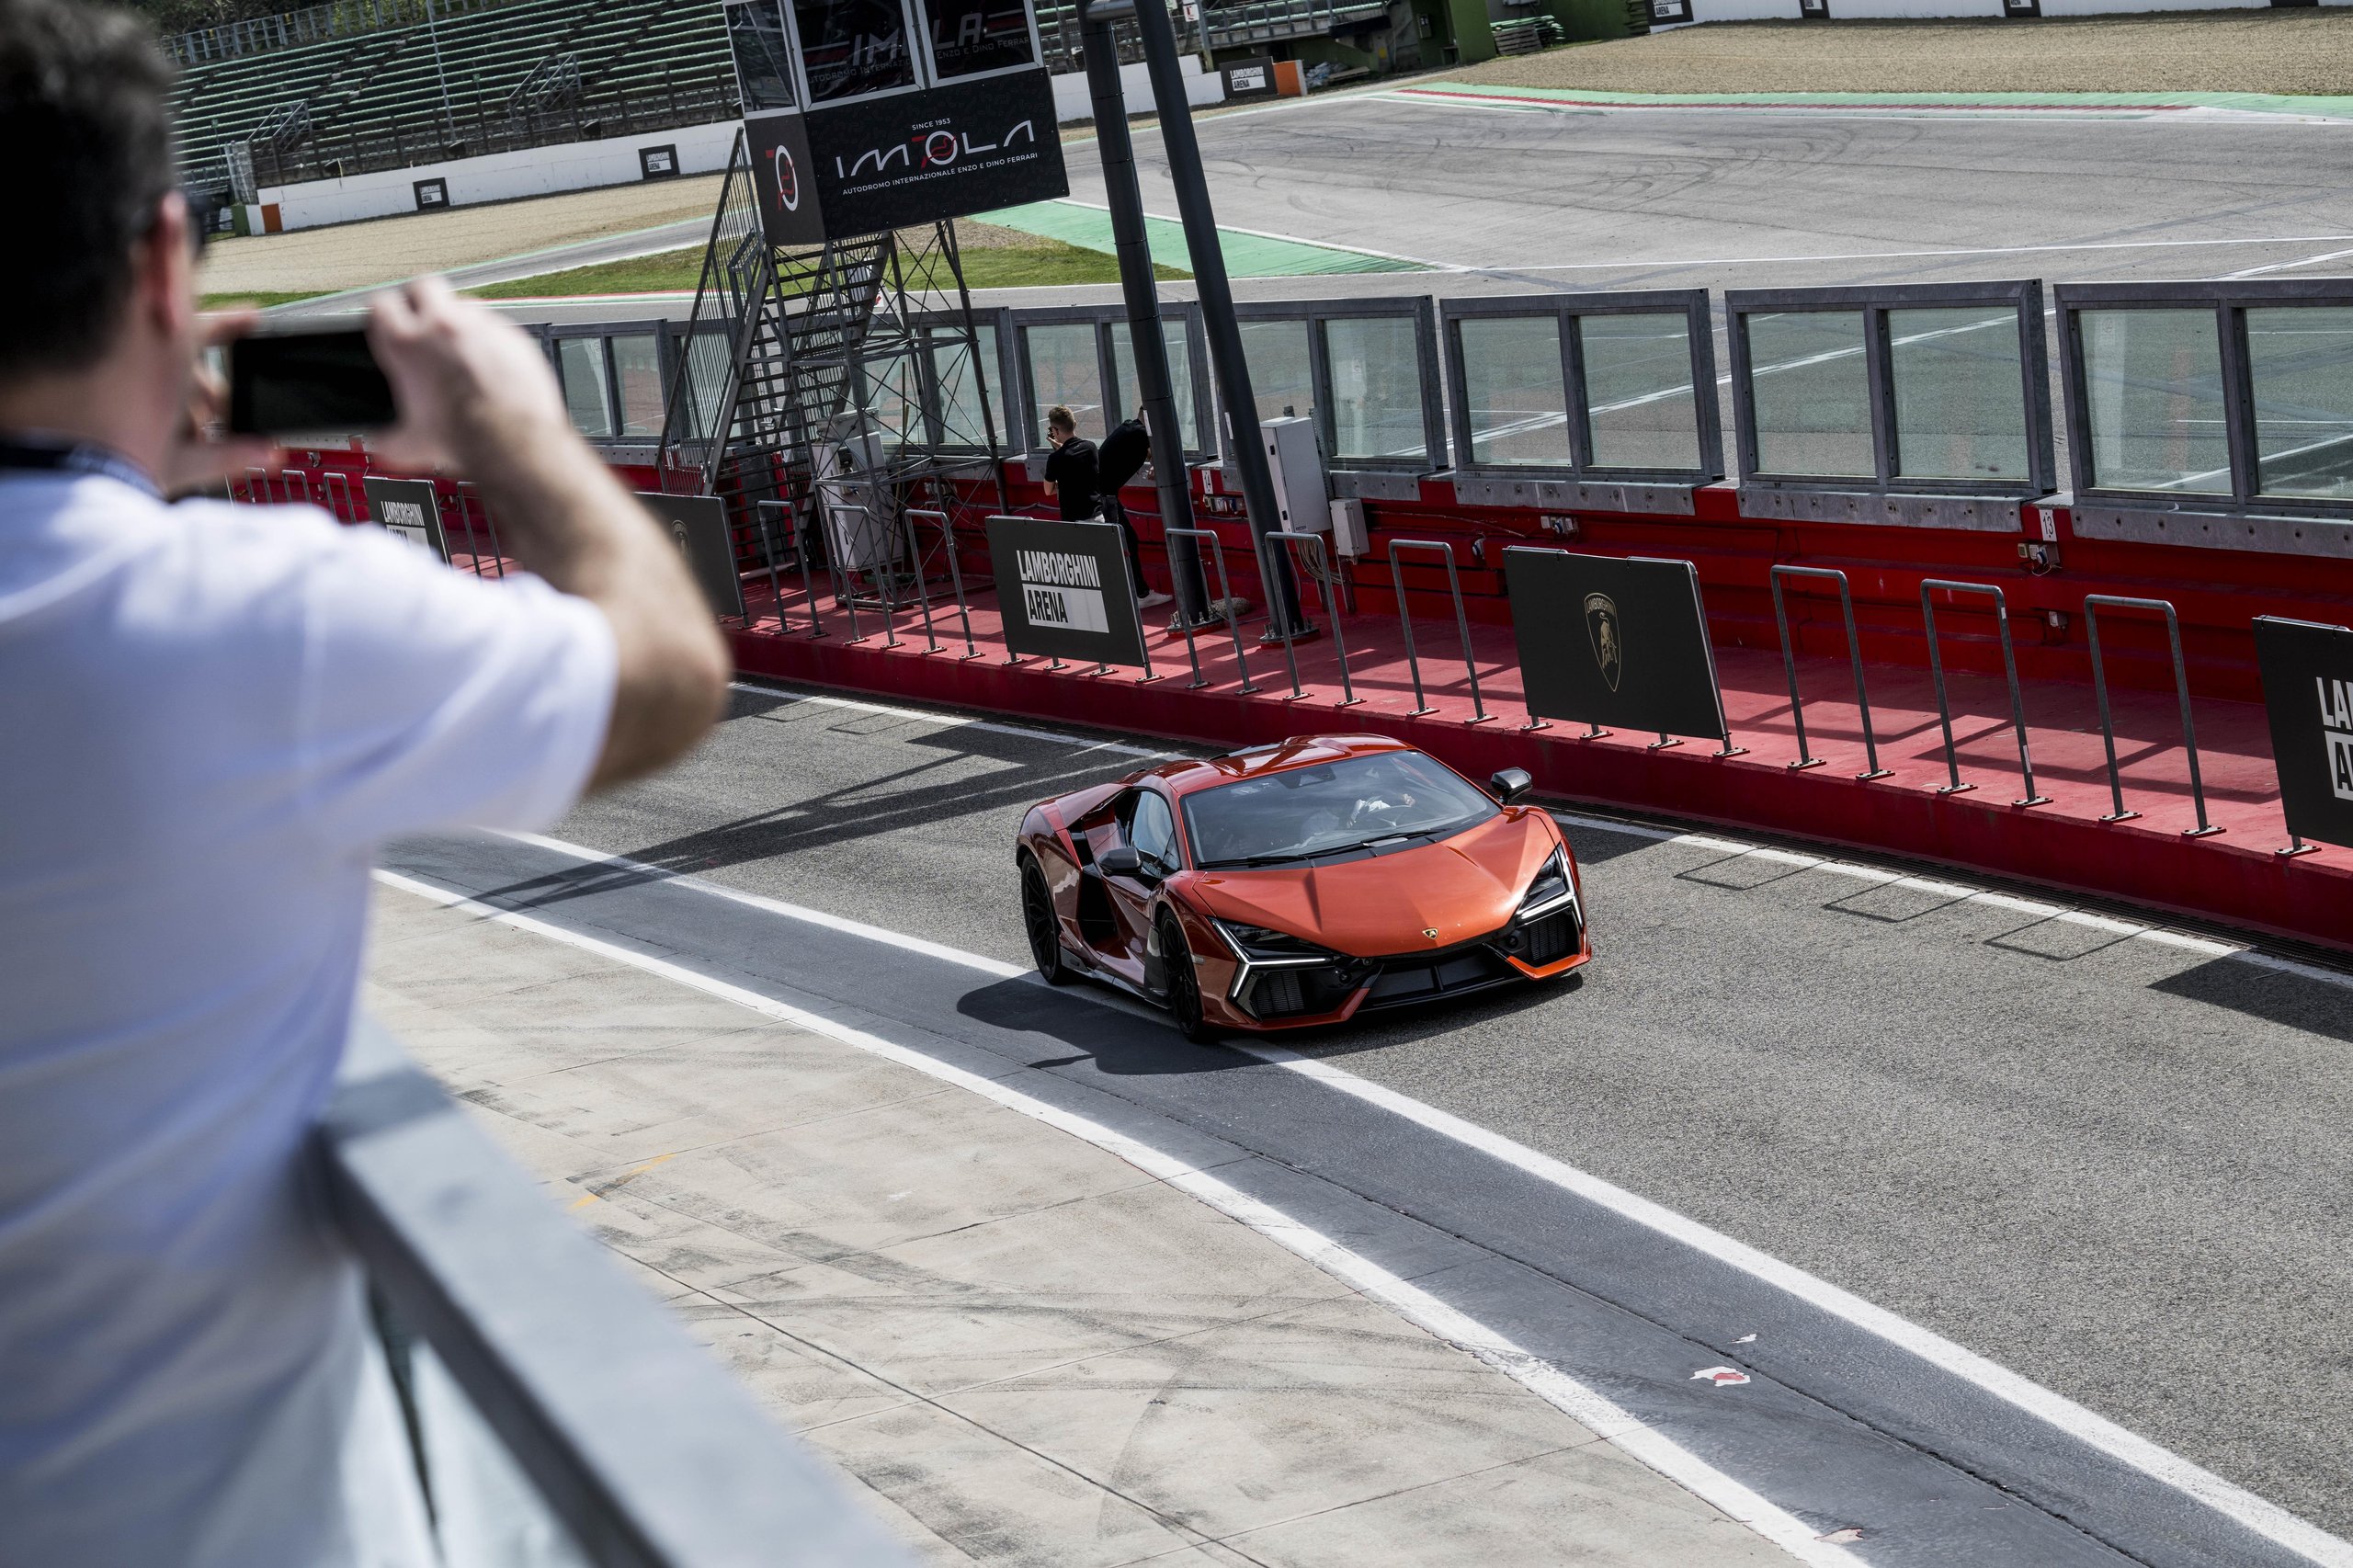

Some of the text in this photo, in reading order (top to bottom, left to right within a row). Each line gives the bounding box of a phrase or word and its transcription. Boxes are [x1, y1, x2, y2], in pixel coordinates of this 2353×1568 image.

[853, 12, 983, 66] IMLA
[808, 68, 856, 84] UTODROMO
[936, 50, 961, 60] ENZO
[972, 42, 995, 53] DINO
[997, 37, 1029, 48] FERRAR
[1233, 79, 1250, 89] ARENA
[912, 118, 951, 131] SINCE 1953
[835, 119, 1035, 178] IMOLA
[843, 180, 891, 195] AUTODROMO
[892, 167, 956, 186] INTERNAZIONALE
[958, 164, 978, 174] ENZO
[986, 158, 1006, 168] DINO
[1007, 153, 1039, 164] FERRARI
[2042, 516, 2054, 535] 13
[1016, 550, 1101, 588] LAMBORGHINI
[1027, 589, 1068, 623] ARENA
[2316, 676, 2353, 731] LA
